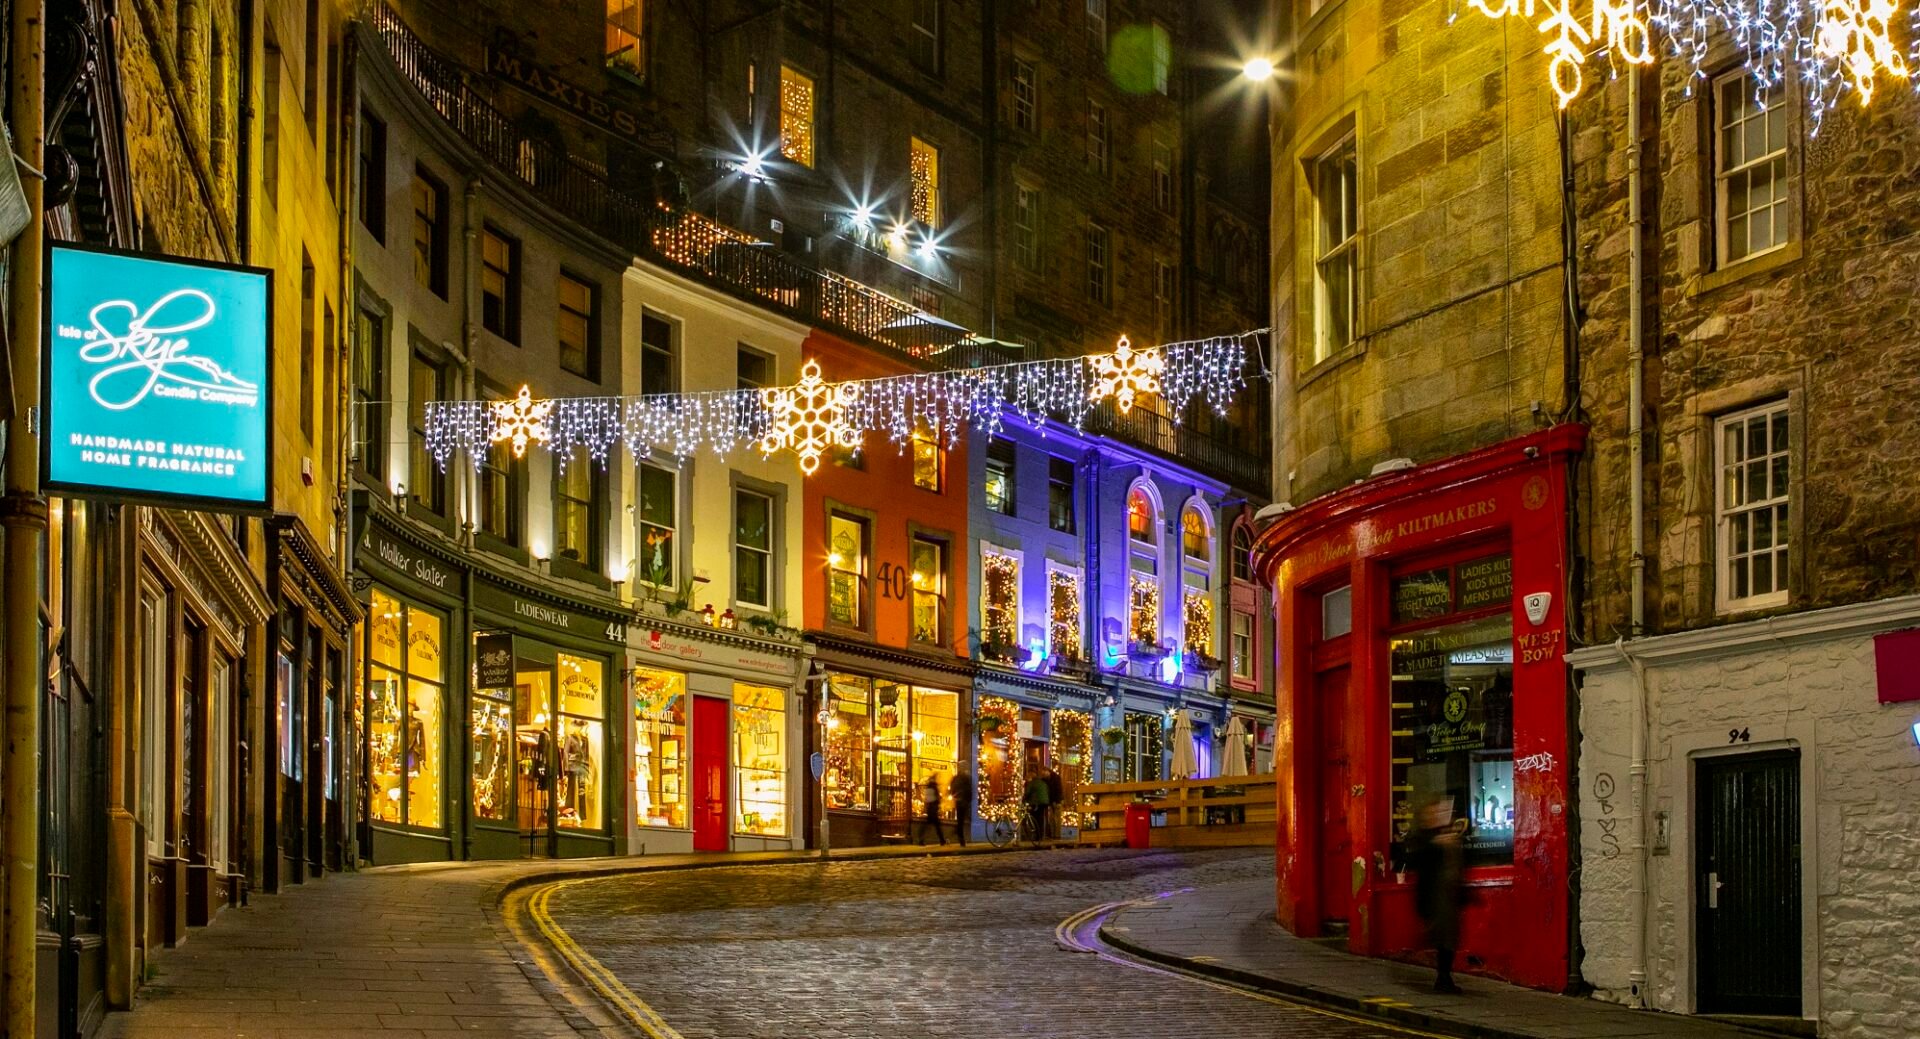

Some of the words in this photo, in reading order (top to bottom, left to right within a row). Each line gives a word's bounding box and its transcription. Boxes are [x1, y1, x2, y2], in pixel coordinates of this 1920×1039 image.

[495, 52, 636, 135] MAXIES
[58, 324, 82, 339] Isle
[84, 328, 98, 341] of
[80, 289, 215, 410] Skye
[154, 383, 197, 400] Candle
[199, 388, 258, 407] Company
[71, 433, 166, 453] HANDMADE
[172, 443, 245, 462] NATURAL
[82, 450, 131, 466] HOME
[138, 456, 235, 476] FRAGRANCE
[1398, 497, 1496, 537] KILTMAKERS
[380, 539, 410, 571] Walker
[415, 559, 447, 588] Slater
[1461, 563, 1492, 580] LADIES
[1494, 558, 1512, 570] KILT
[877, 562, 906, 601] 40
[1466, 579, 1487, 591] KIDS
[1489, 572, 1512, 586] KILTS
[1425, 592, 1452, 607] WOOL
[1463, 592, 1490, 605] MENS
[514, 600, 568, 627] LADIESWEAR
[640, 635, 651, 647] the
[651, 639, 661, 649] red
[662, 641, 677, 650] door
[679, 645, 703, 658] gallery
[1433, 636, 1445, 651] IN
[1518, 629, 1561, 650] WEST
[1406, 656, 1436, 672] MADE
[1452, 647, 1506, 663] MEASURE
[1522, 646, 1555, 664] BOW
[1728, 727, 1751, 744] 94
